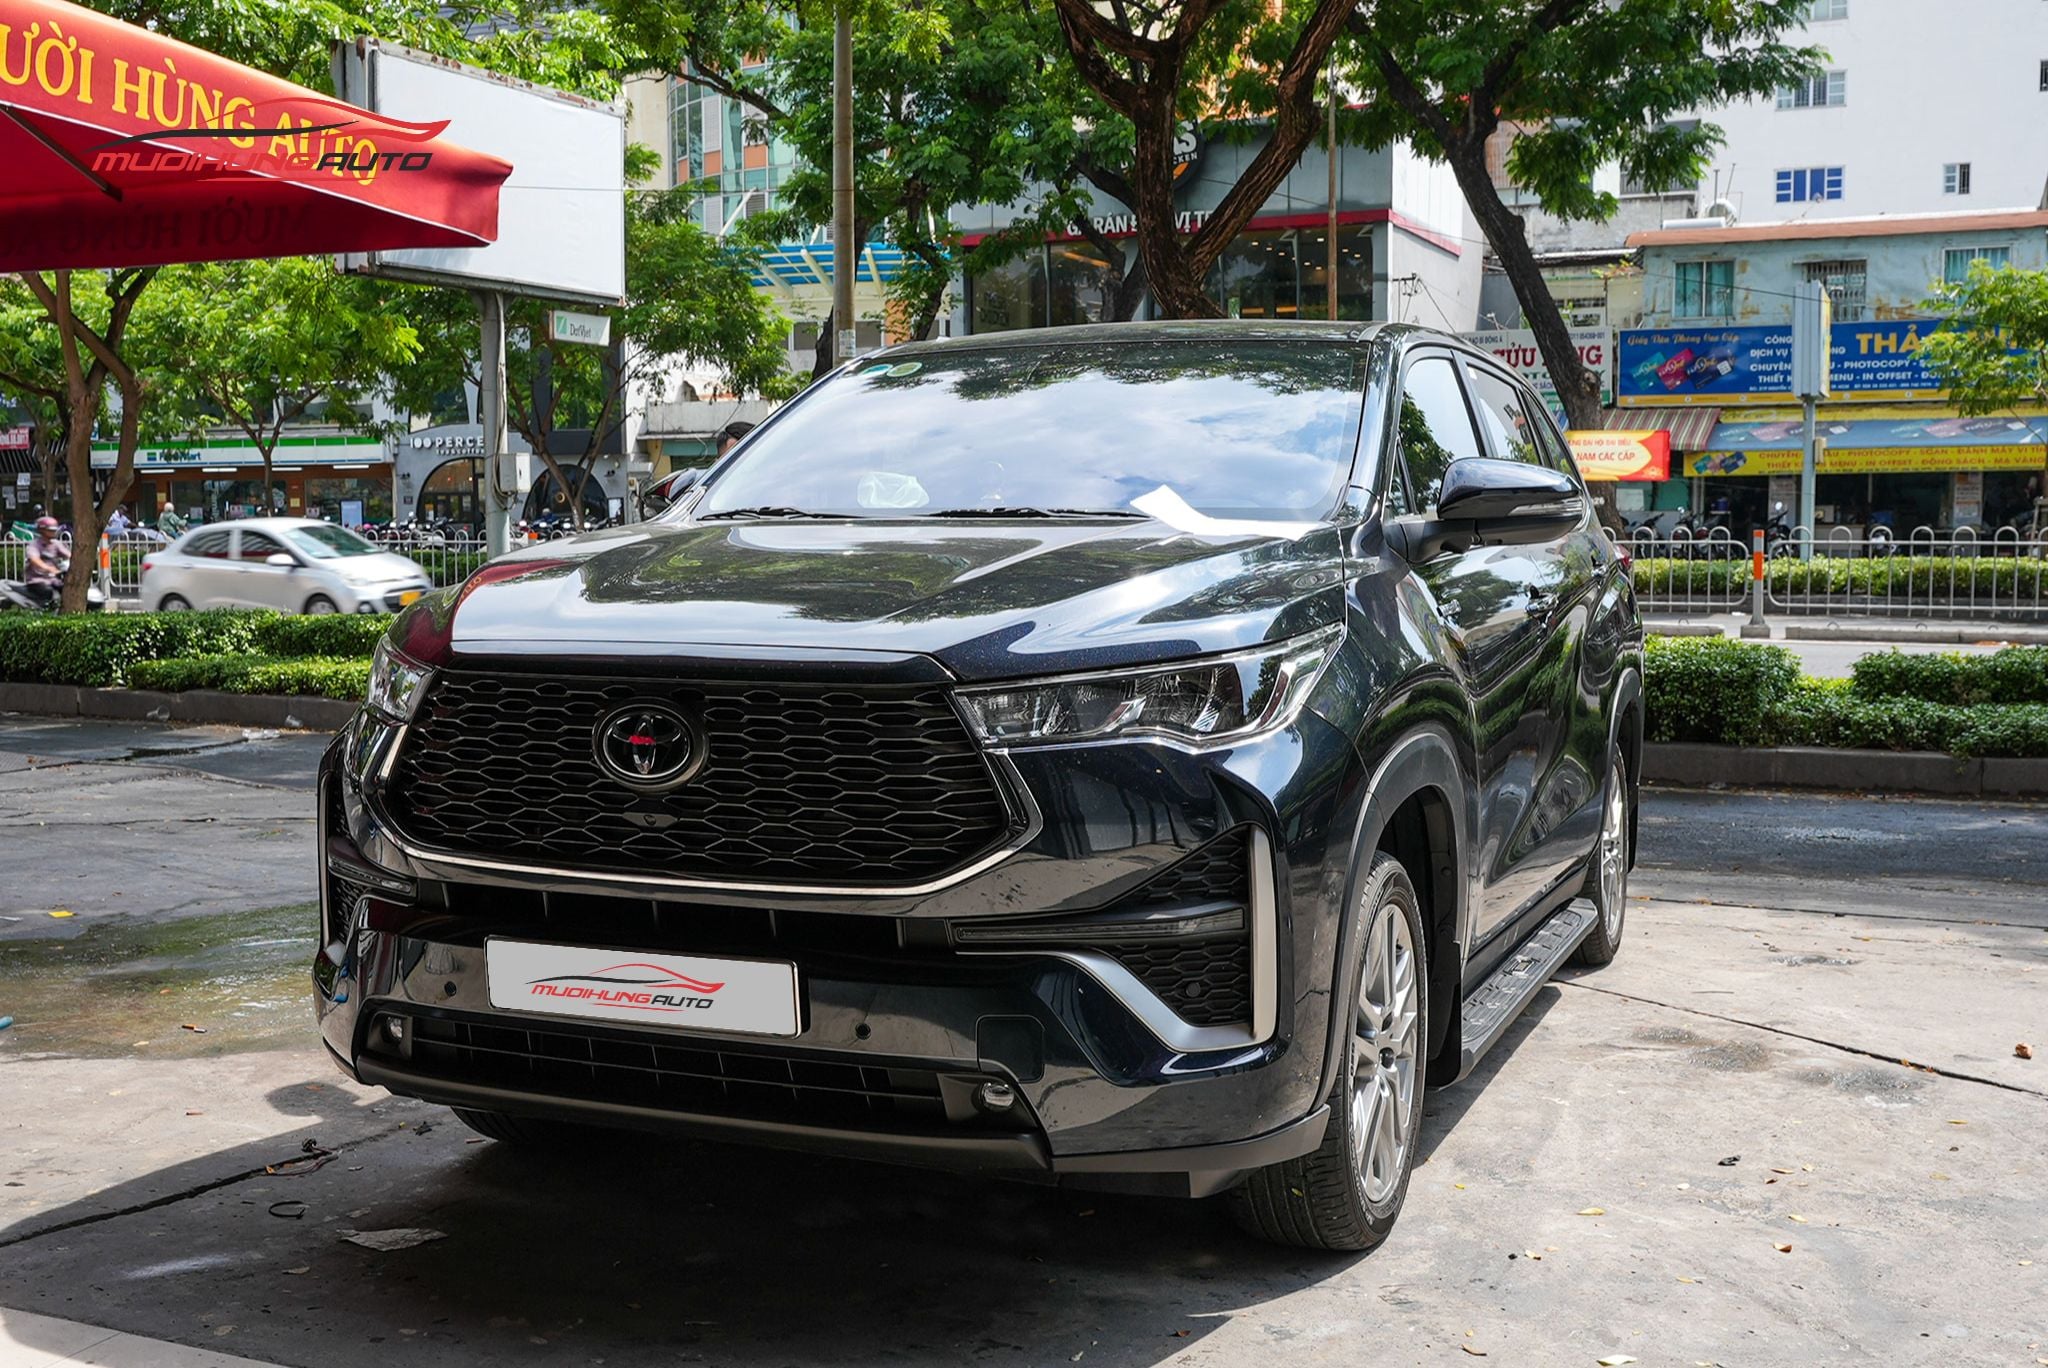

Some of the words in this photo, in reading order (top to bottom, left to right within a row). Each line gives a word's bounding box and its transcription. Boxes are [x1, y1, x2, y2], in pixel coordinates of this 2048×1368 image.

[112, 57, 256, 148] HÙNG
[1094, 212, 1128, 234] RÁN
[1750, 361, 1792, 371] CHUYÊN
[1844, 360, 1910, 369] PHOTOCOPY
[1758, 372, 1784, 383] THIẾT
[1862, 373, 1874, 381] IN
[1876, 371, 1913, 380] OFFSET
[1848, 449, 1911, 457] PHOTOCOPY
